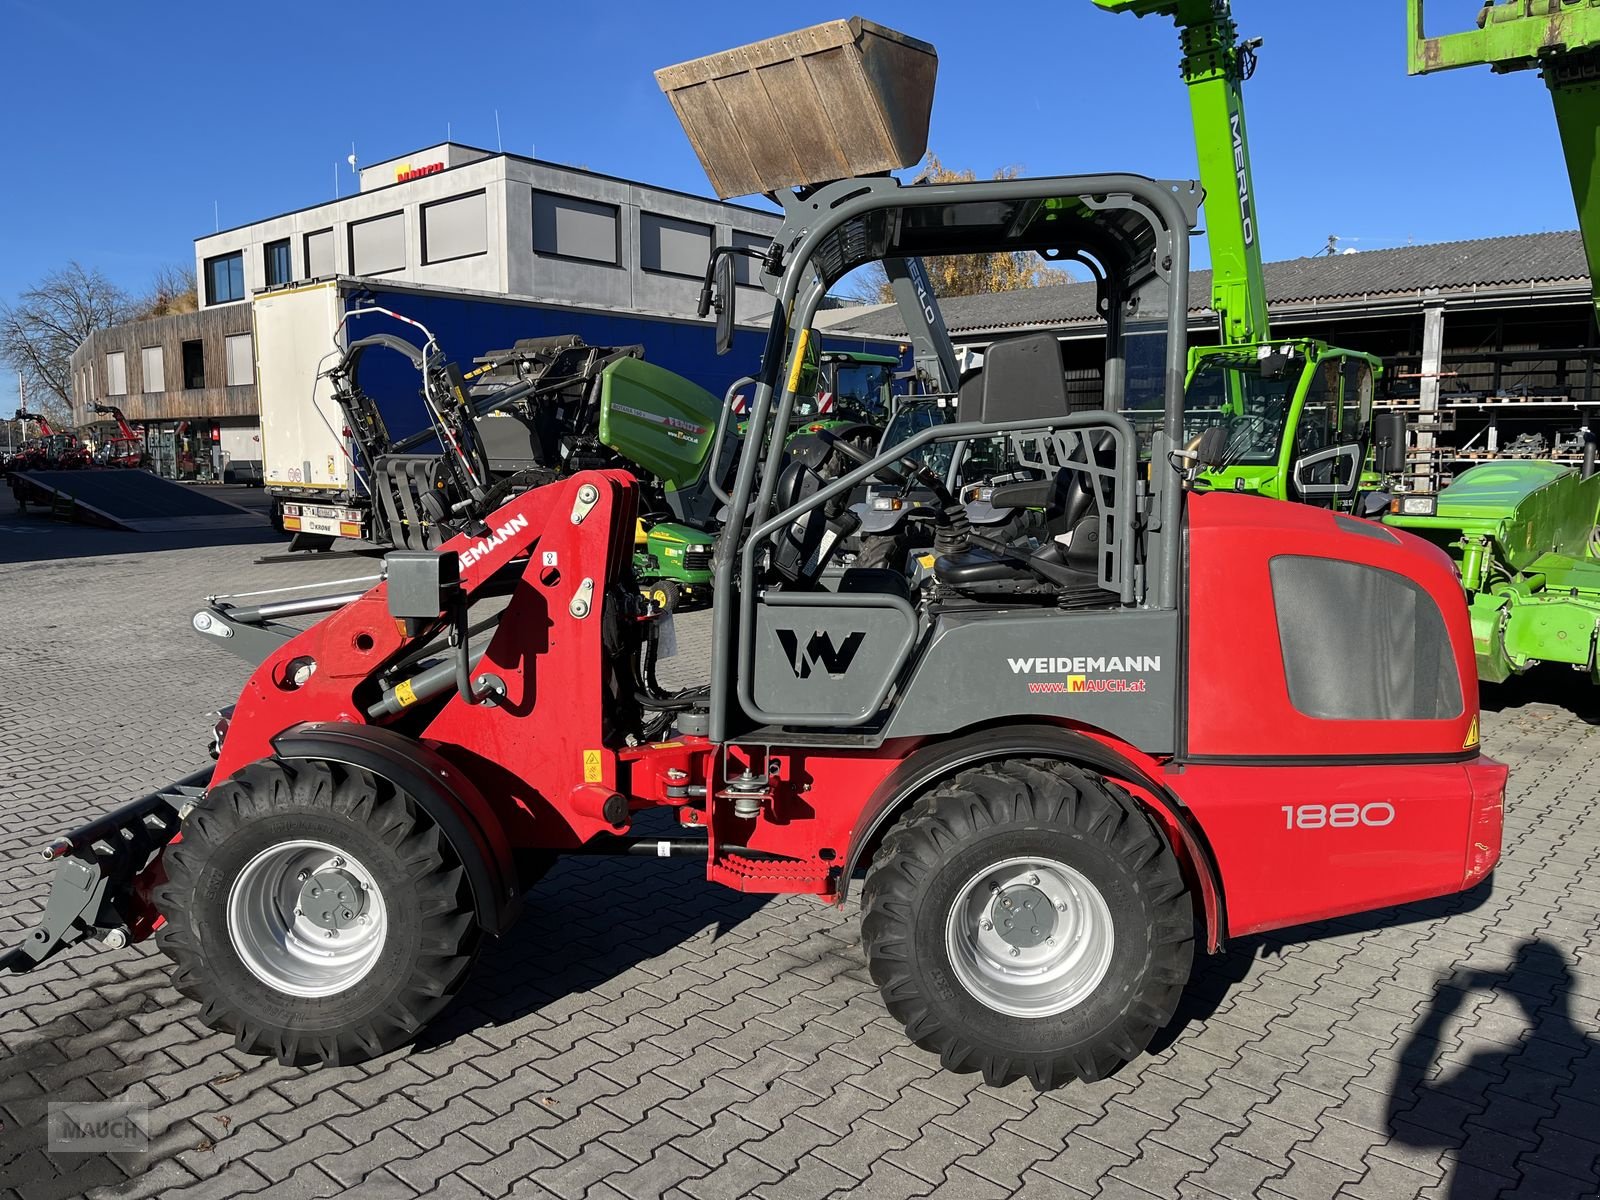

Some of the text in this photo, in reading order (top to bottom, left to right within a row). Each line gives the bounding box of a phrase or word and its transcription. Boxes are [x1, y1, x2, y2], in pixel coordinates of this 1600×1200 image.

[1230, 114, 1253, 245] MERLO
[668, 416, 700, 433] FENDT
[314, 524, 331, 532] KRONE
[1007, 655, 1161, 674] WEIDEMANN
[1028, 678, 1146, 693] www.MAUCH.at
[1281, 802, 1395, 830] 1880
